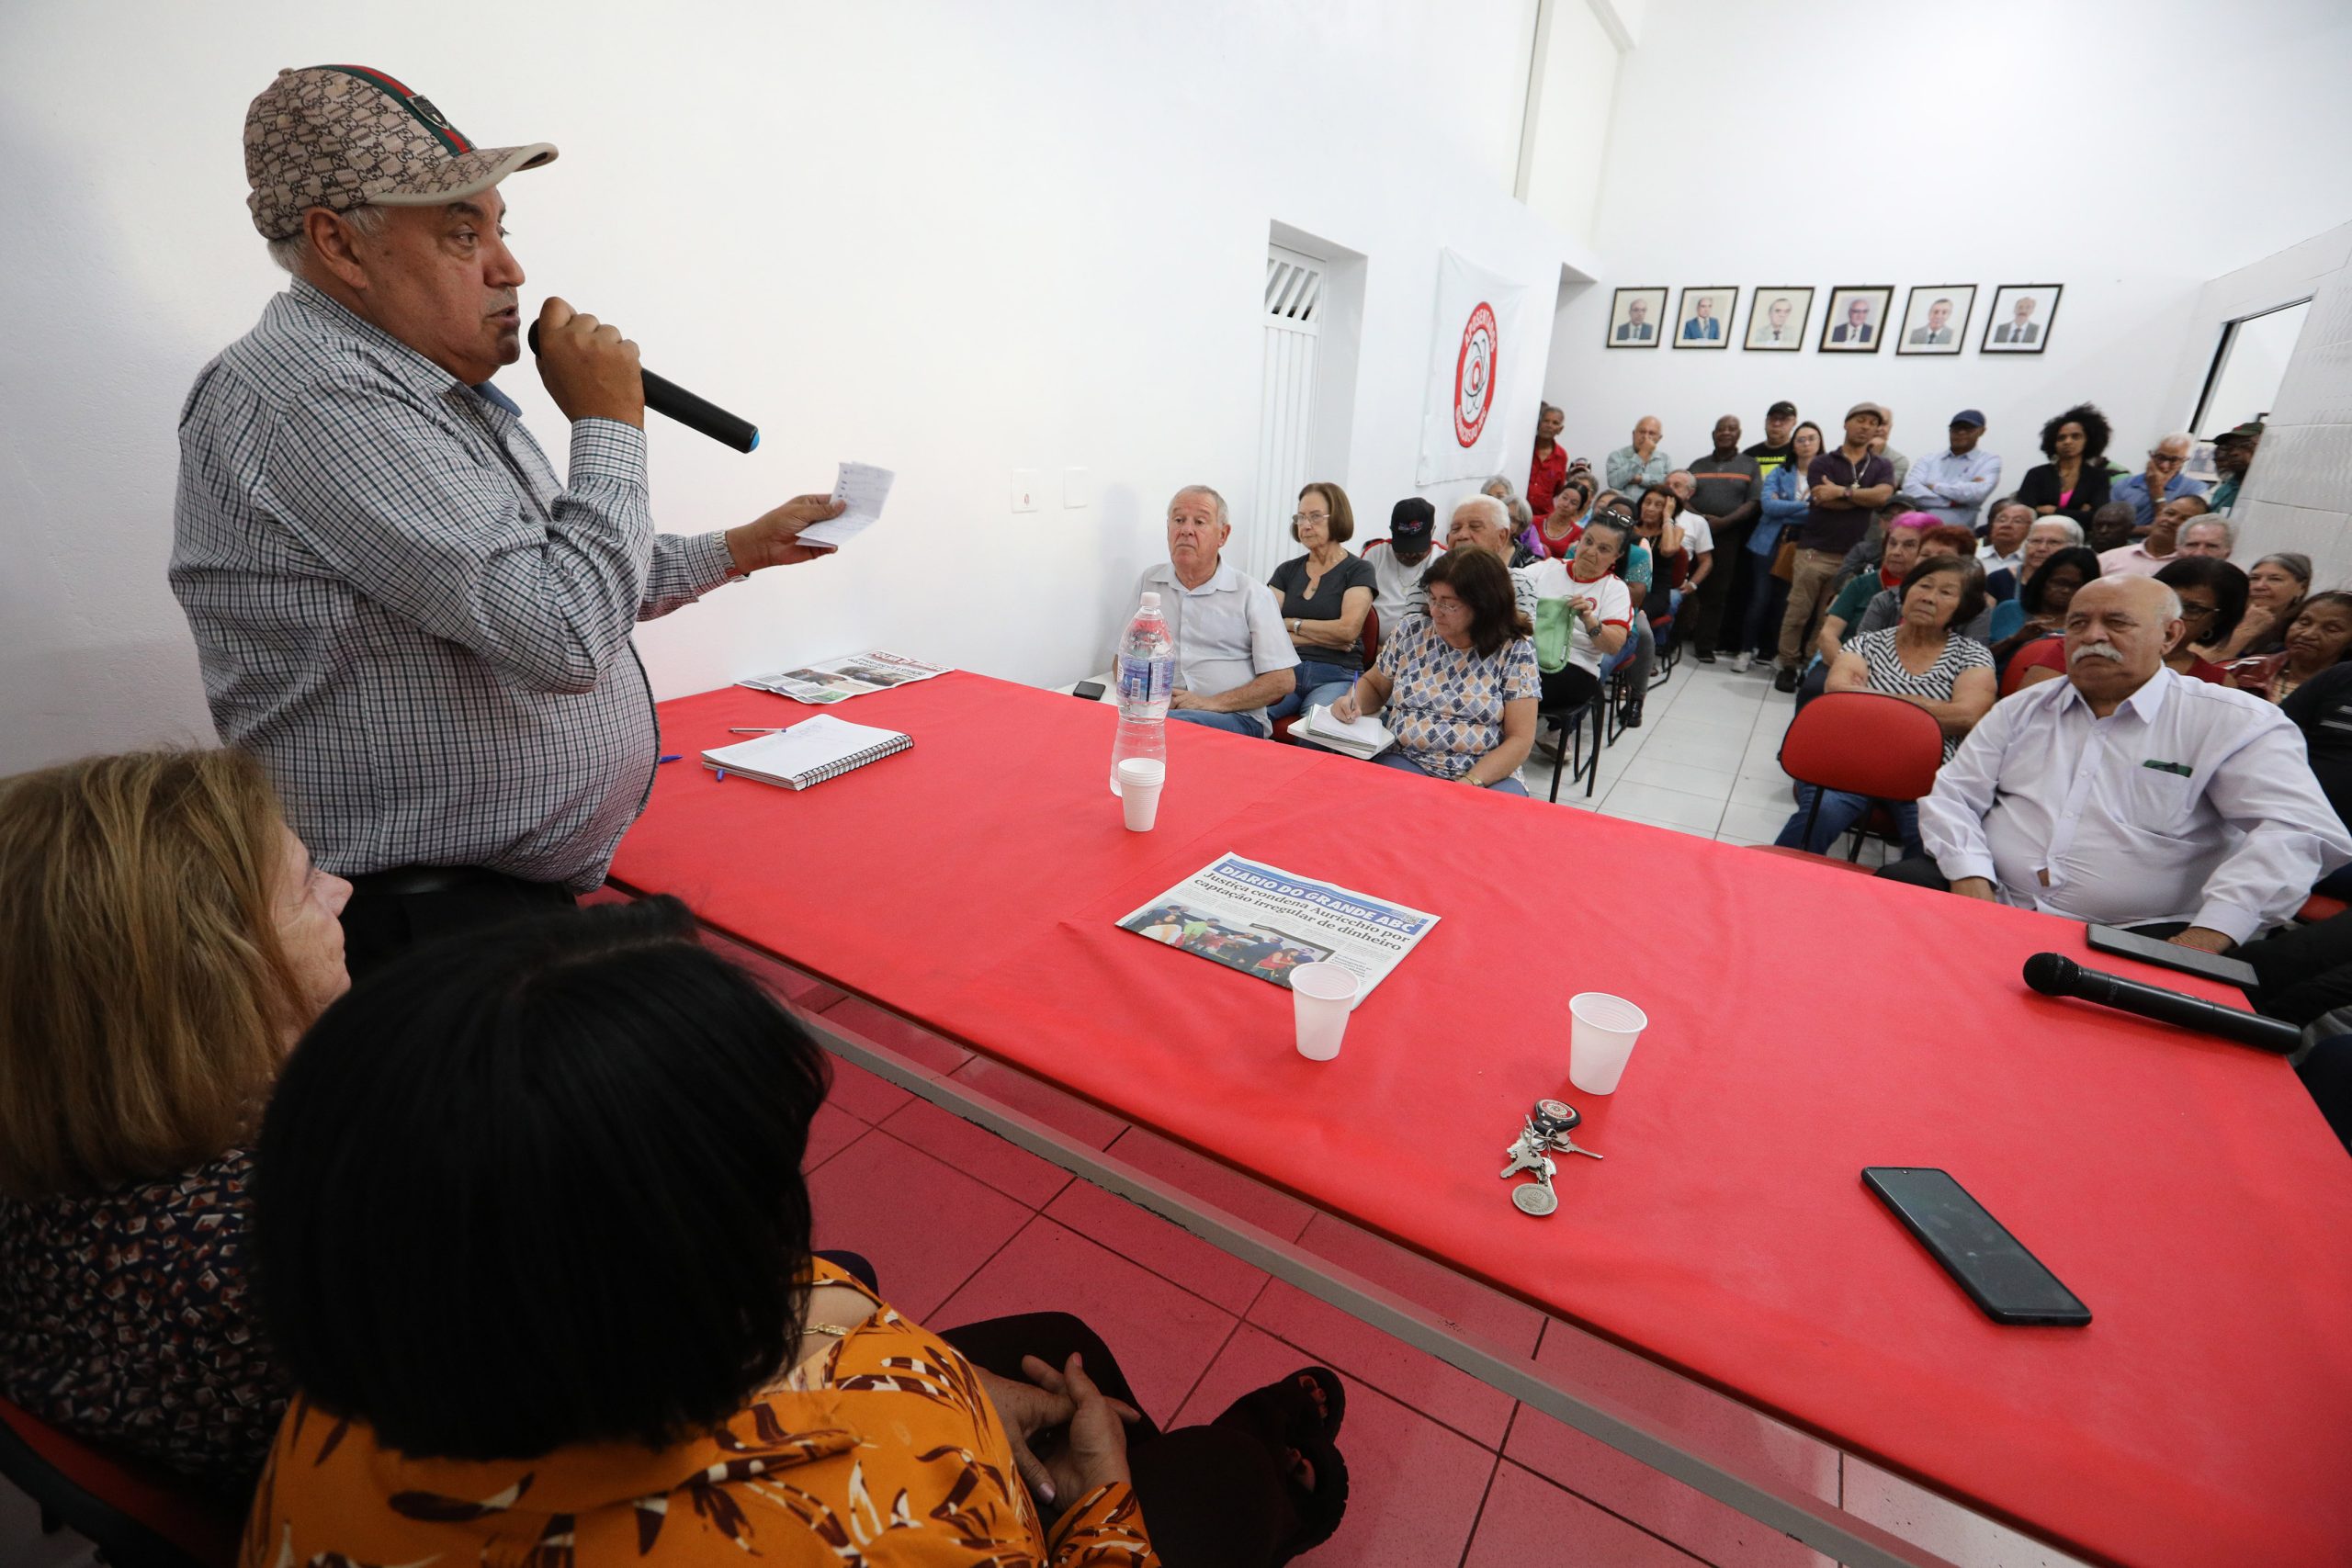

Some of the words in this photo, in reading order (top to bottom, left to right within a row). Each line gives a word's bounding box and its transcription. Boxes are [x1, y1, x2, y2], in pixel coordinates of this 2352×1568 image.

[1194, 878, 1252, 902] captação
[1254, 898, 1317, 924] irregular
[1317, 916, 1336, 930] de
[1337, 926, 1402, 952] dinheiro
[1204, 872, 1250, 893] Justiça
[1251, 889, 1309, 909] condena
[1310, 907, 1380, 933] Auricchio
[1380, 930, 1410, 943] por
[1277, 884, 1305, 897] DO
[1305, 892, 1379, 921] GRANDE
[1375, 916, 1416, 932] ABC
